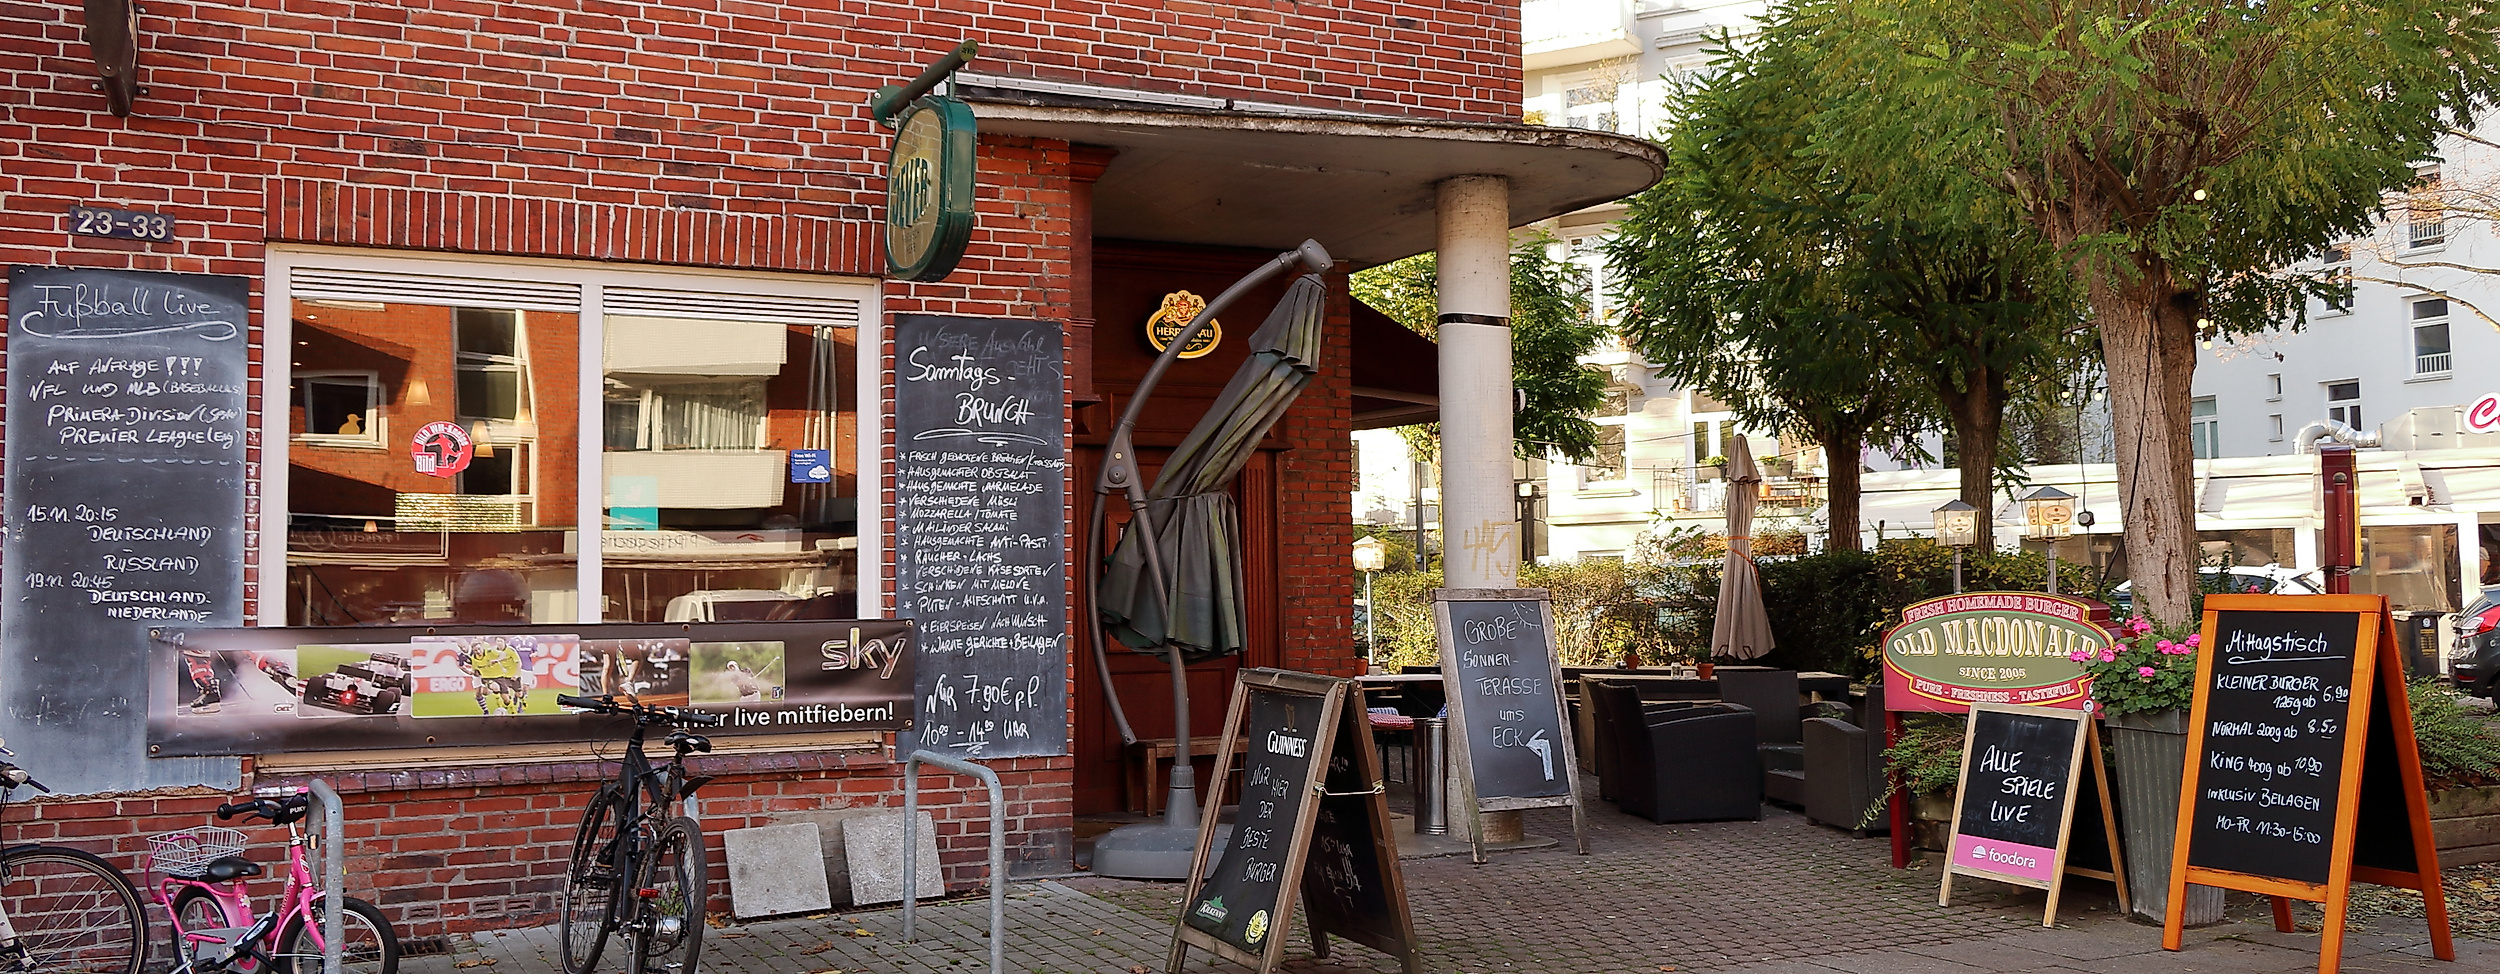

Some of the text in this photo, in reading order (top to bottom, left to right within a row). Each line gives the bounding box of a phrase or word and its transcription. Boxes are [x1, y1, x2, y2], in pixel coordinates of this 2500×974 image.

[76, 209, 168, 239] 23-33
[33, 283, 220, 327] Fußball live
[28, 380, 67, 401] NFL
[954, 393, 1035, 428] BRUNCH
[2469, 397, 2500, 429] C
[416, 455, 435, 473] Bild
[908, 450, 937, 462] FRISCH
[75, 503, 119, 522] 20:15
[86, 525, 215, 547] DEUTSCHLAND
[103, 554, 200, 575] RUSSLAND
[70, 571, 115, 589] 20:45
[107, 606, 213, 623] NIEDERLANDE
[1905, 595, 2080, 622] FRESH HOMEMADE BURGER
[1893, 616, 2098, 659] OLD MACDONALD
[2225, 629, 2329, 660] Mittagstisch
[820, 627, 907, 681] sky
[1958, 665, 2027, 681] SINCE 2005
[2216, 673, 2320, 692] KLEINER BURGER
[430, 677, 466, 693] ERGO
[1475, 676, 1543, 697] TERASSE
[1914, 678, 1943, 695] PURE
[1951, 686, 2011, 702] FRESHNESS
[2018, 683, 2075, 702] TASTEFUL
[735, 707, 770, 727] live
[777, 701, 894, 726] mitfiebern!
[1498, 708, 1525, 723] ums
[1492, 726, 1528, 749] ECK
[2211, 721, 2253, 737] NORMAL
[2283, 724, 2298, 738] ab
[1267, 730, 1307, 758] GUINNESS
[1980, 745, 2024, 773] ALLE
[2210, 751, 2245, 772] KING
[2277, 762, 2292, 776] ab
[1250, 762, 1271, 787] NUR
[2001, 776, 2056, 799] SPIELE
[290, 805, 307, 815] PUKY
[1258, 800, 1275, 820] DER
[2259, 788, 2320, 811] BEILAGEN
[1990, 800, 2032, 823] LIVE
[1240, 826, 1273, 850] BESTE
[1989, 848, 2036, 868] foodora
[1242, 857, 1278, 883] BURGER
